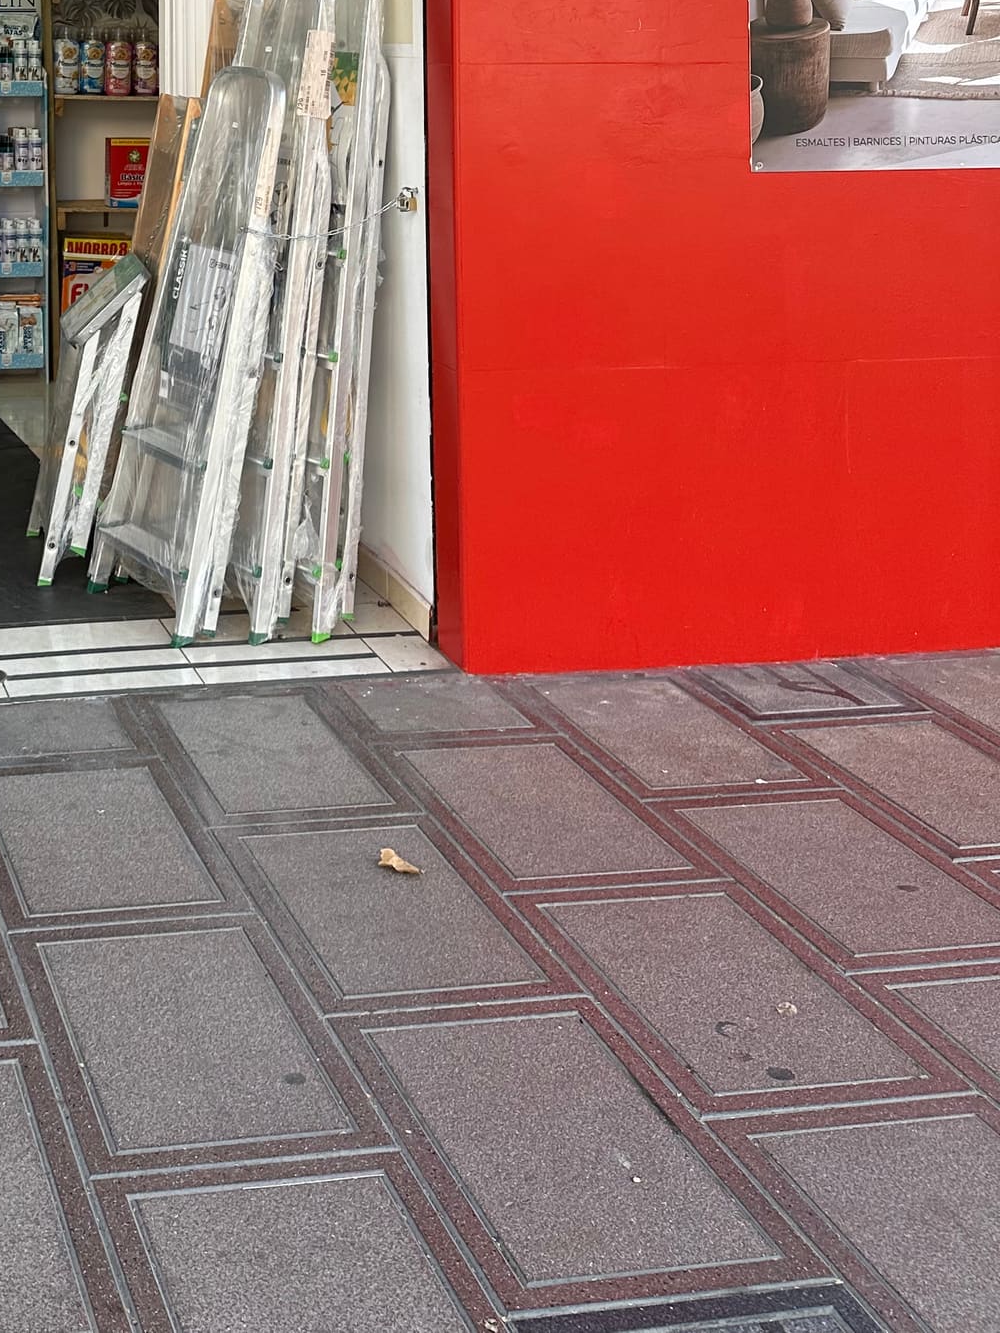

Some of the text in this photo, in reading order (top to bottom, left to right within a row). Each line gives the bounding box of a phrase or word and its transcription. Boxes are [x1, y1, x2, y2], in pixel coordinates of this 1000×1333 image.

[796, 139, 846, 147] ESMALTES
[853, 137, 901, 146] BARNICES
[909, 136, 957, 145] PINTURAS
